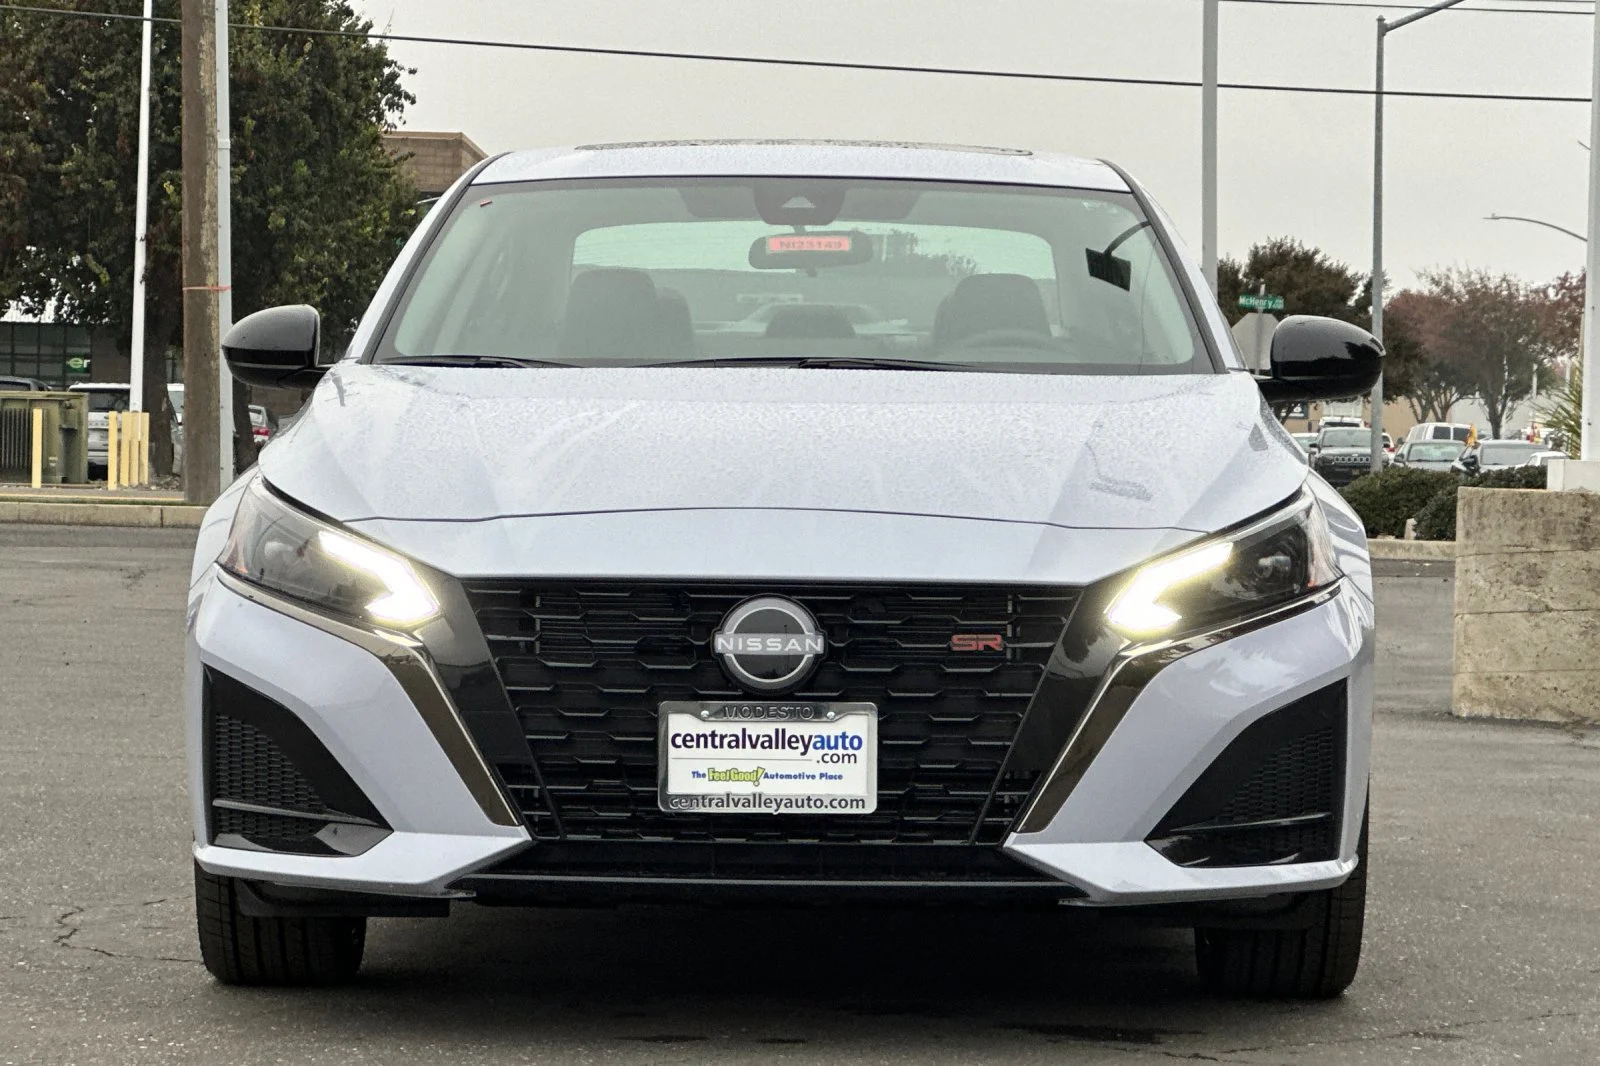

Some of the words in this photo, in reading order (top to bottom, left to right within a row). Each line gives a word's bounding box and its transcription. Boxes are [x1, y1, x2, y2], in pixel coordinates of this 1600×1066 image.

[1238, 296, 1273, 309] McHenry
[717, 636, 823, 651] NISSAN
[950, 634, 1004, 651] SR
[723, 705, 815, 720] MODESTO
[670, 727, 863, 756] centralvalleyauto
[816, 751, 857, 764] .com
[691, 770, 706, 779] The
[763, 771, 816, 780] Automotive
[819, 771, 843, 780] Place
[668, 792, 866, 813] centralvalleyauto.com
